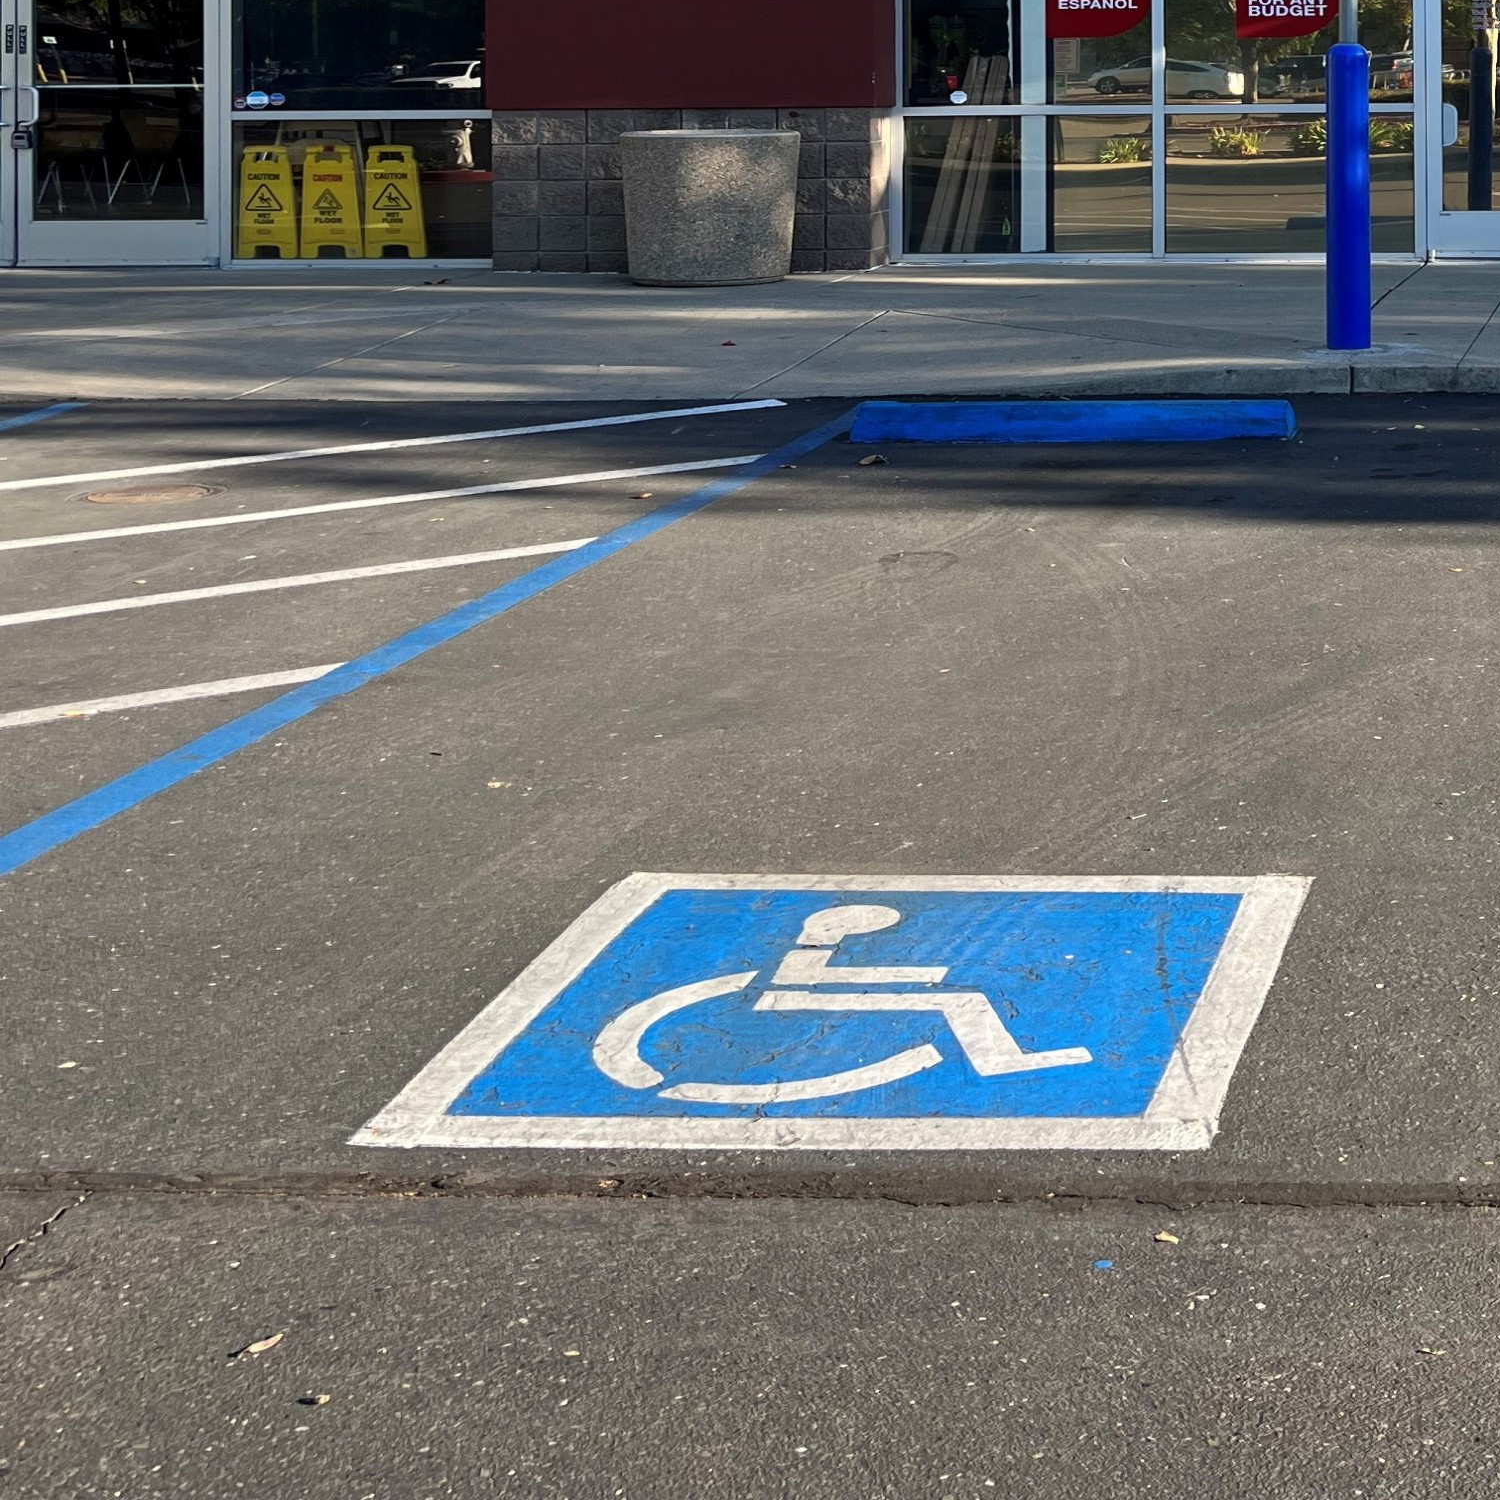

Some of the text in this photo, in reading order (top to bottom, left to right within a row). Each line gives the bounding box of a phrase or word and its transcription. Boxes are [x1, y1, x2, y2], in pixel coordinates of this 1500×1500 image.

[1248, 5, 1328, 17] BUDGET
[247, 173, 280, 181] CAUTION
[373, 172, 408, 180] CAUTION
